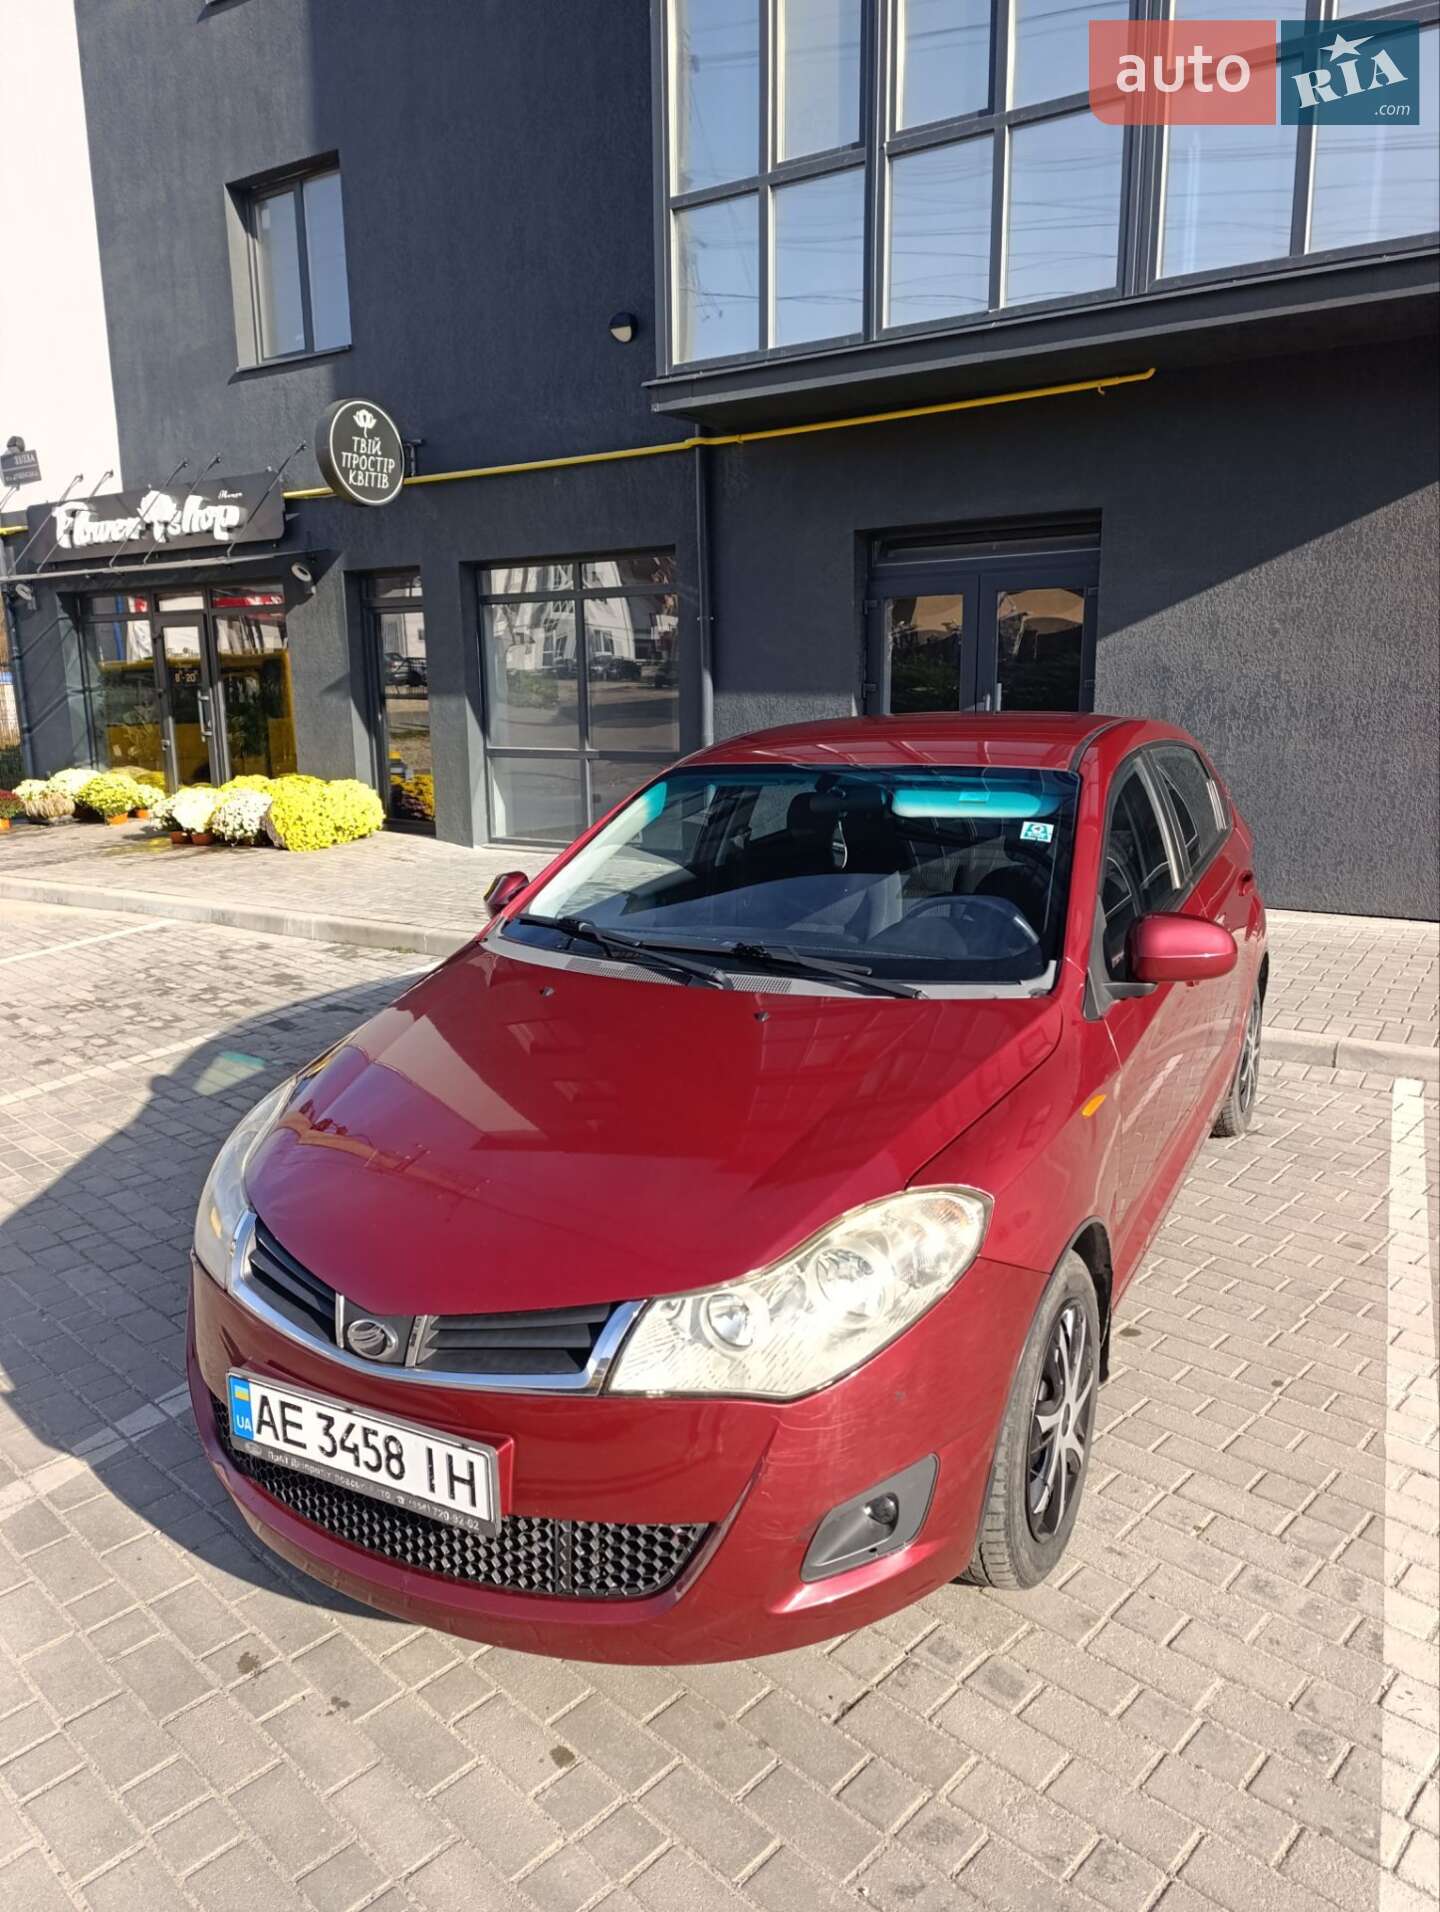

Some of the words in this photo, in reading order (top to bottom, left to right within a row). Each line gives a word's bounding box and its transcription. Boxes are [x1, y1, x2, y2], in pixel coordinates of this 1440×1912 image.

[352, 436, 382, 455] ТВІЙ
[341, 451, 395, 473] ПРОСТІР
[349, 469, 389, 489] КВІТІВ
[51, 502, 144, 549] Flower
[168, 494, 241, 541] shop
[236, 1414, 253, 1431] UA
[256, 1394, 307, 1450] AE
[316, 1411, 406, 1481] 3458
[426, 1446, 477, 1508] IH
